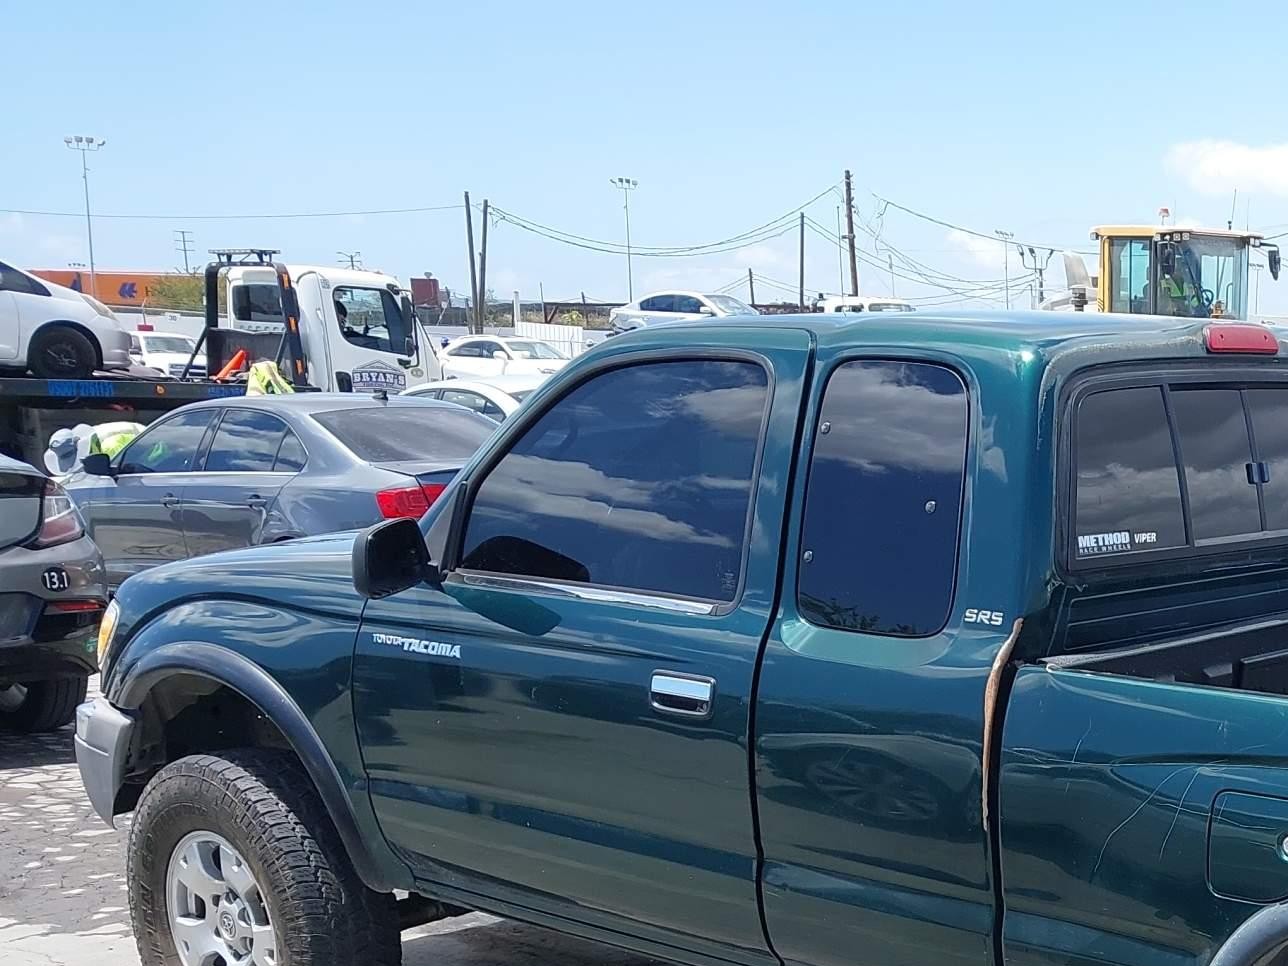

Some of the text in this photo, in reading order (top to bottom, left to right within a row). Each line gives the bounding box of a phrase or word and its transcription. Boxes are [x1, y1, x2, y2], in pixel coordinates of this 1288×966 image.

[353, 372, 405, 385] BRYAN'S
[1078, 531, 1157, 548] METHOD VIPER
[43, 571, 69, 589] 13.1
[964, 608, 1004, 626] SRS
[372, 633, 462, 659] TOYOTA TACOMA
